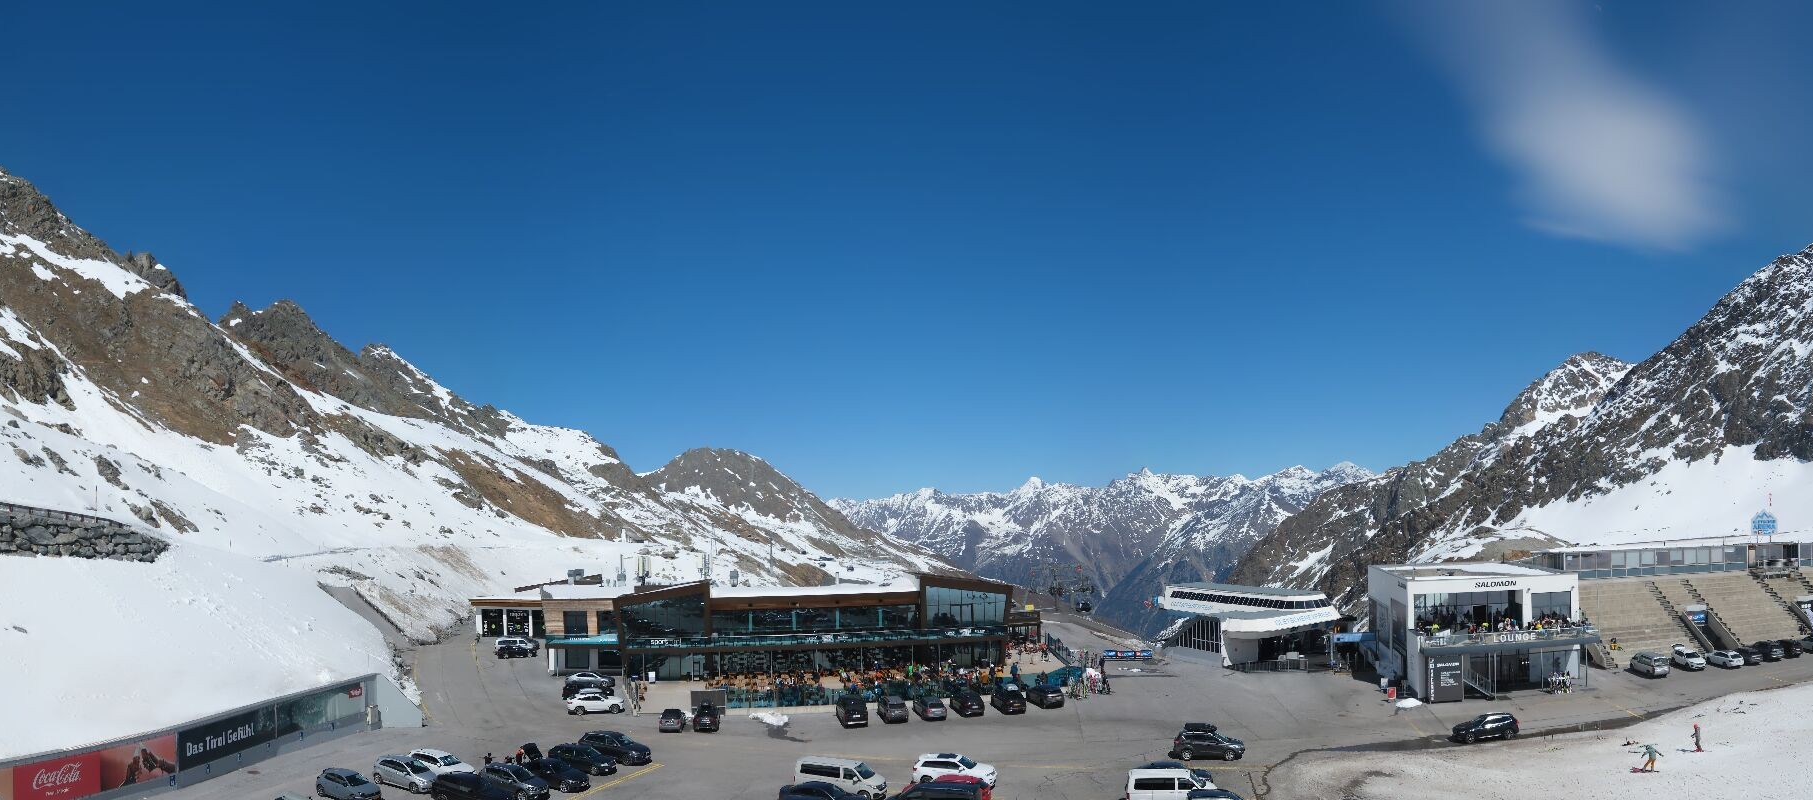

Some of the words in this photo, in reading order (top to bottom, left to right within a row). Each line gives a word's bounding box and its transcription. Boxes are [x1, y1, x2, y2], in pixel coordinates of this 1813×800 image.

[1474, 580, 1517, 588] SALOMON
[1493, 632, 1537, 643] LOUNGE
[186, 742, 204, 757] Das
[205, 731, 226, 751] Tirol
[227, 722, 255, 744] Gefühl
